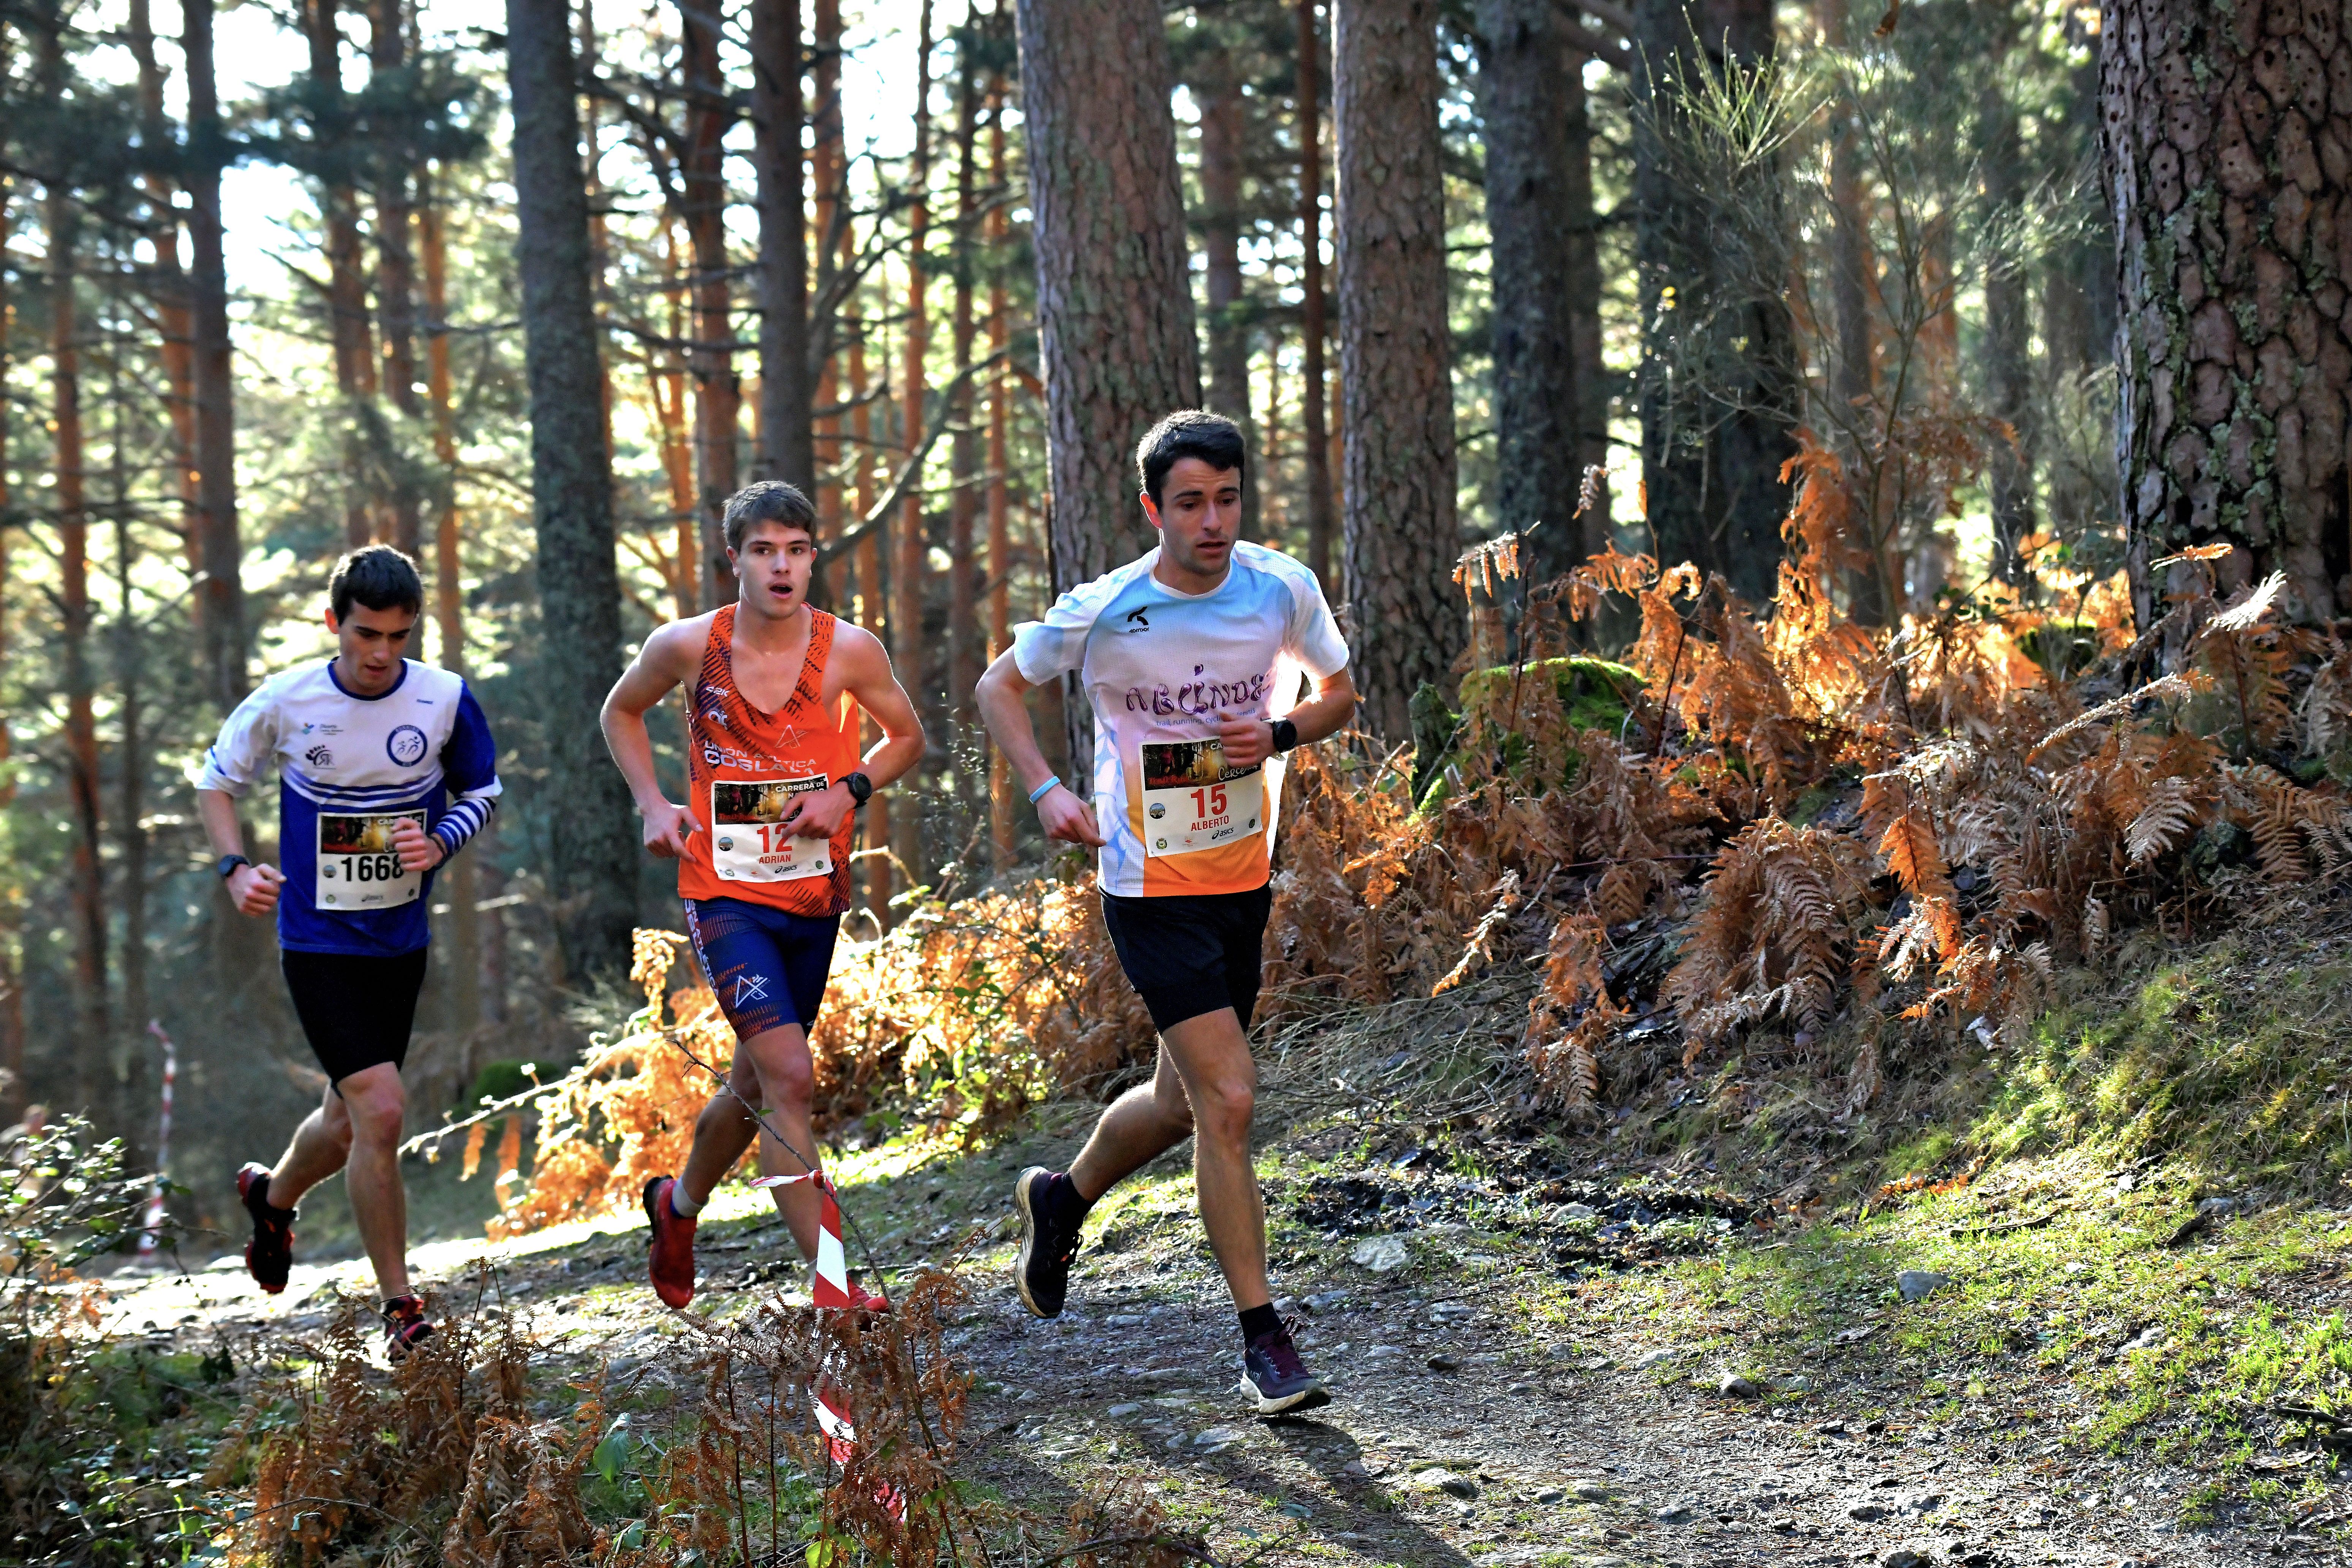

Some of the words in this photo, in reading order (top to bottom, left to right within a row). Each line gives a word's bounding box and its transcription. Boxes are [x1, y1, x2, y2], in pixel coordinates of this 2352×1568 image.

[706, 686, 730, 697] 42K
[705, 741, 748, 757] UNIÓN
[775, 782, 815, 792] CARRERA
[1190, 784, 1227, 818] 15
[1191, 815, 1230, 831] ALBERTO
[757, 824, 792, 854] 12
[1220, 827, 1234, 837] asics
[759, 854, 791, 864] ADRIAN
[341, 855, 404, 882] 1668
